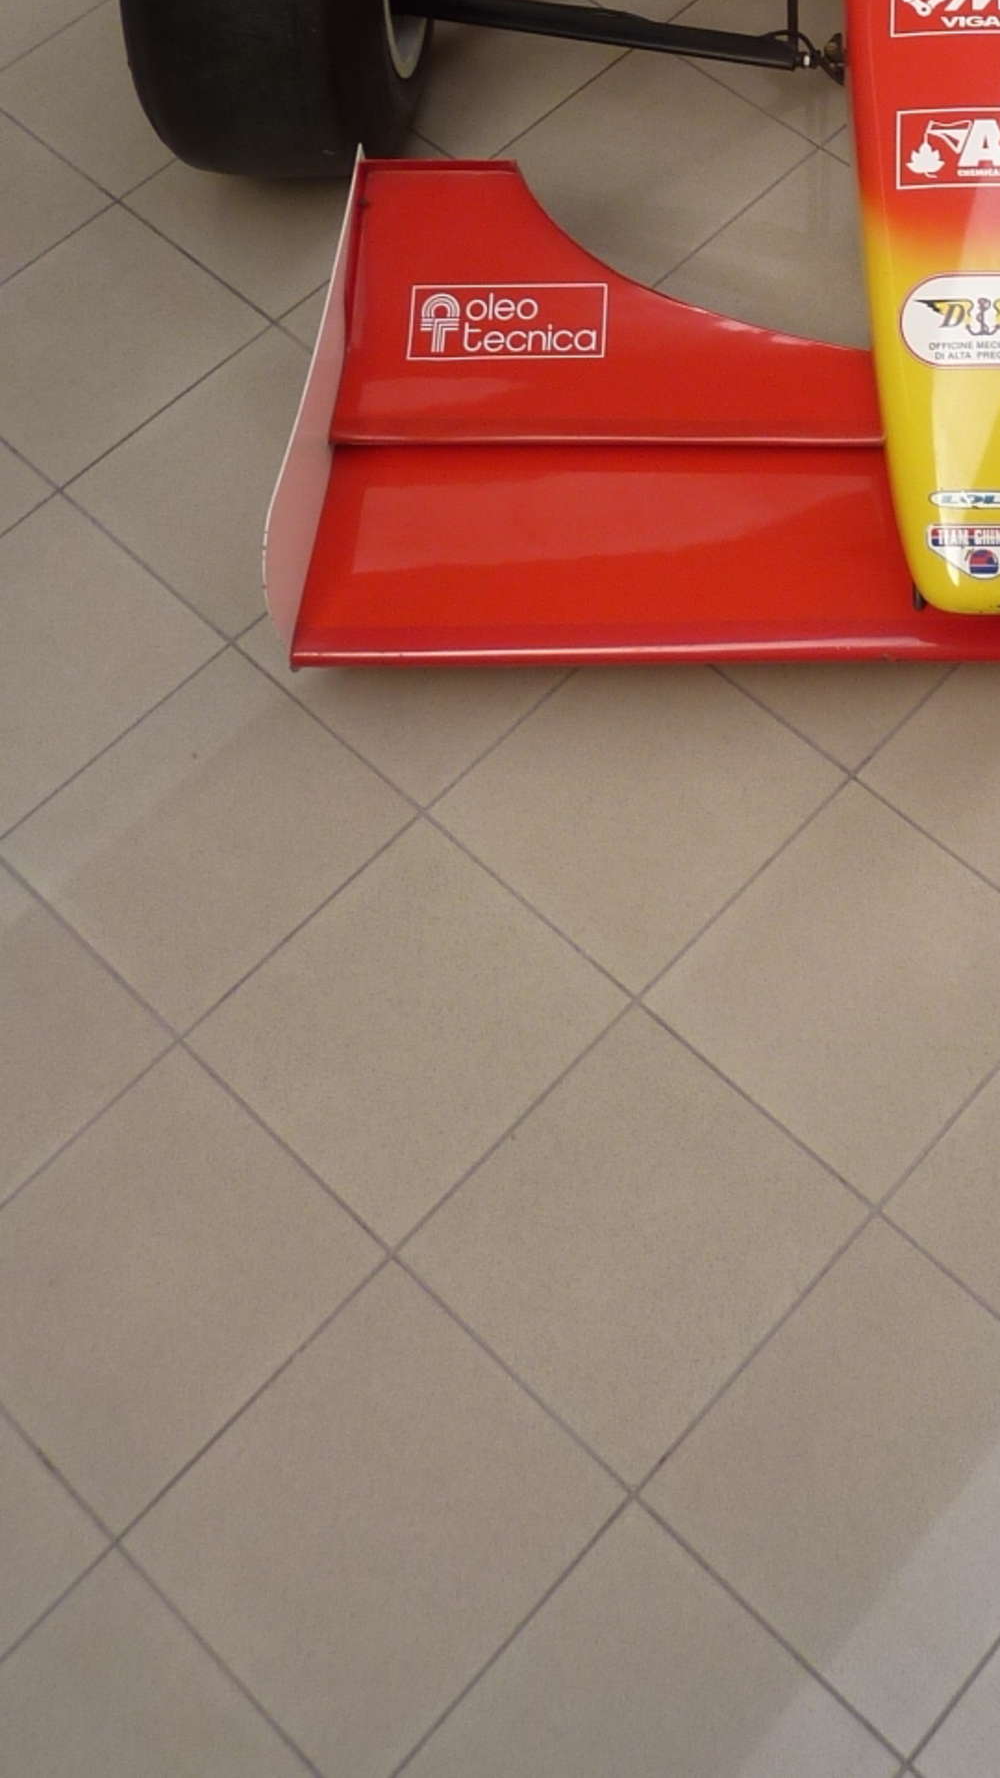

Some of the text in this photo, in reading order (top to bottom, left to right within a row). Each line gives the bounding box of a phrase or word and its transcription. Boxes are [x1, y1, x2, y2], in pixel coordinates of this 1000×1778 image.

[465, 292, 539, 321] oleo
[463, 322, 598, 353] tecnica
[928, 342, 974, 351] OFFICINE
[934, 352, 945, 360] DI
[947, 352, 972, 360] ALTA
